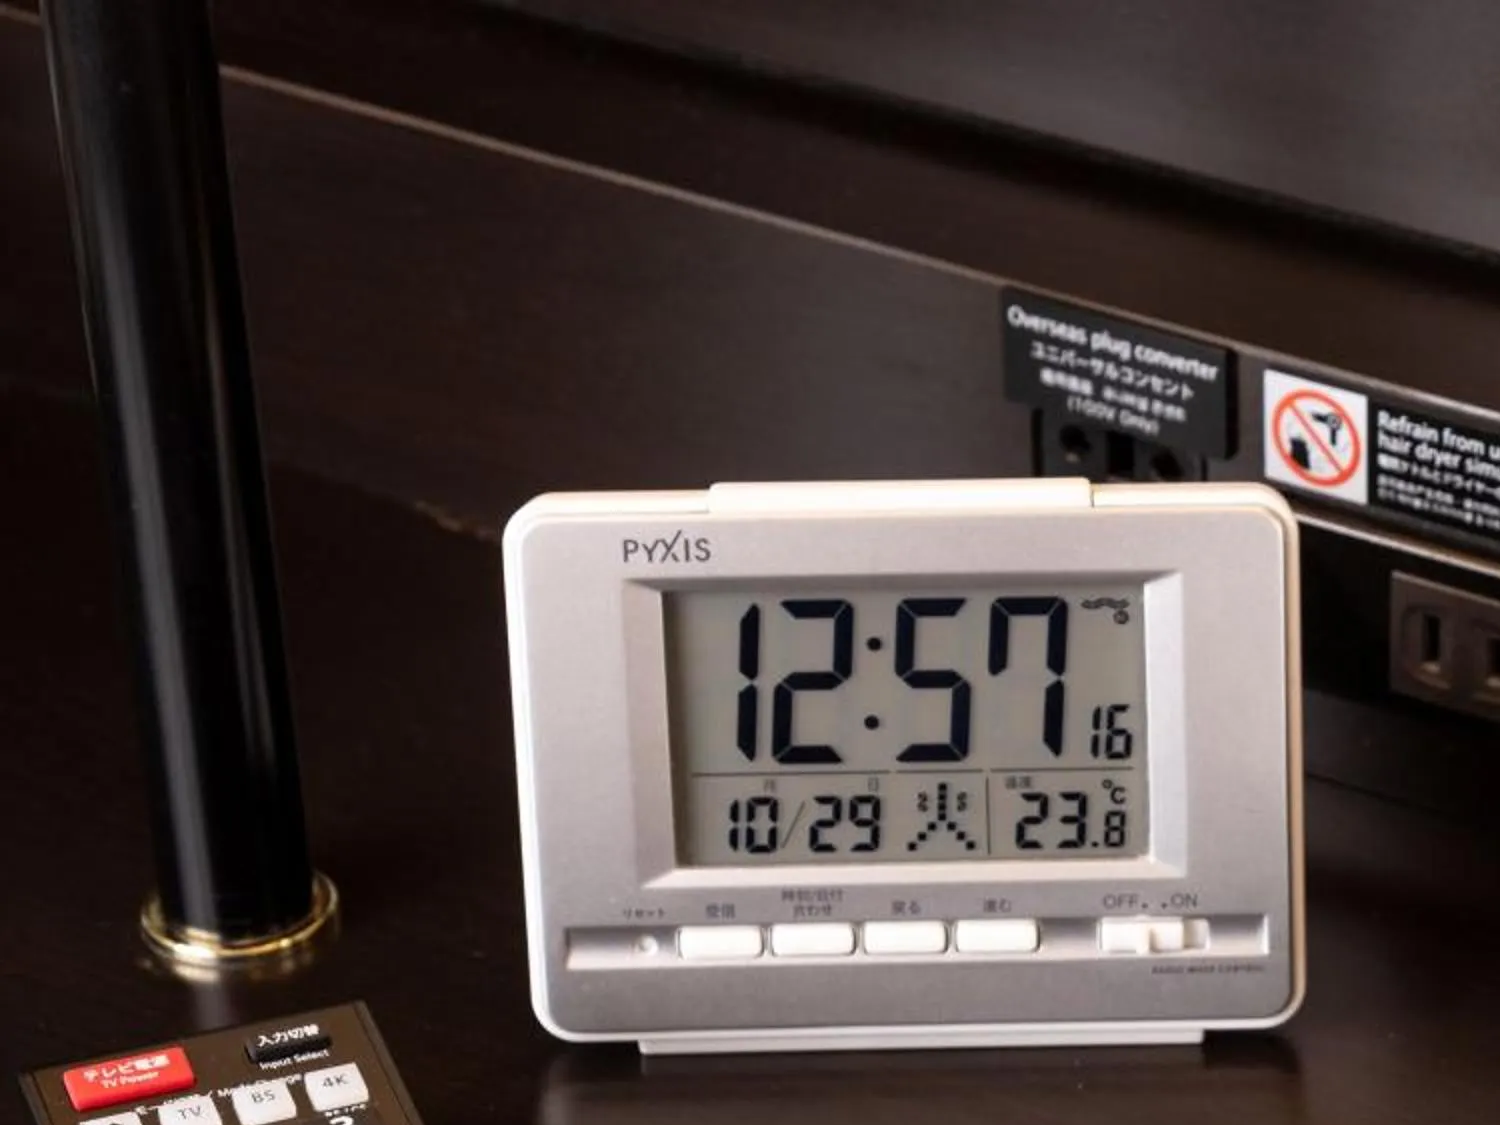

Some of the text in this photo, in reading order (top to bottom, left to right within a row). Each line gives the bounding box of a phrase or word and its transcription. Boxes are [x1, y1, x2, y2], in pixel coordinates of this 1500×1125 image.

[1007, 304, 1219, 382] Overseas plug converter
[1377, 410, 1439, 443] Refrain
[1442, 427, 1485, 455] from
[1377, 429, 1412, 455] hair
[1414, 442, 1462, 470] dryer
[623, 529, 711, 563] PYXIS
[736, 596, 1068, 763] 12:57
[1091, 704, 1133, 760] 16
[729, 796, 881, 853] 10/29
[1015, 791, 1126, 849] 23.8
[1103, 893, 1139, 909] OFF
[1170, 893, 1198, 909] ON
[259, 1049, 330, 1070] Input Select
[101, 1078, 117, 1088] TV
[251, 1089, 275, 1104] BS
[322, 1073, 349, 1088] 4K
[178, 1104, 201, 1119] TV
